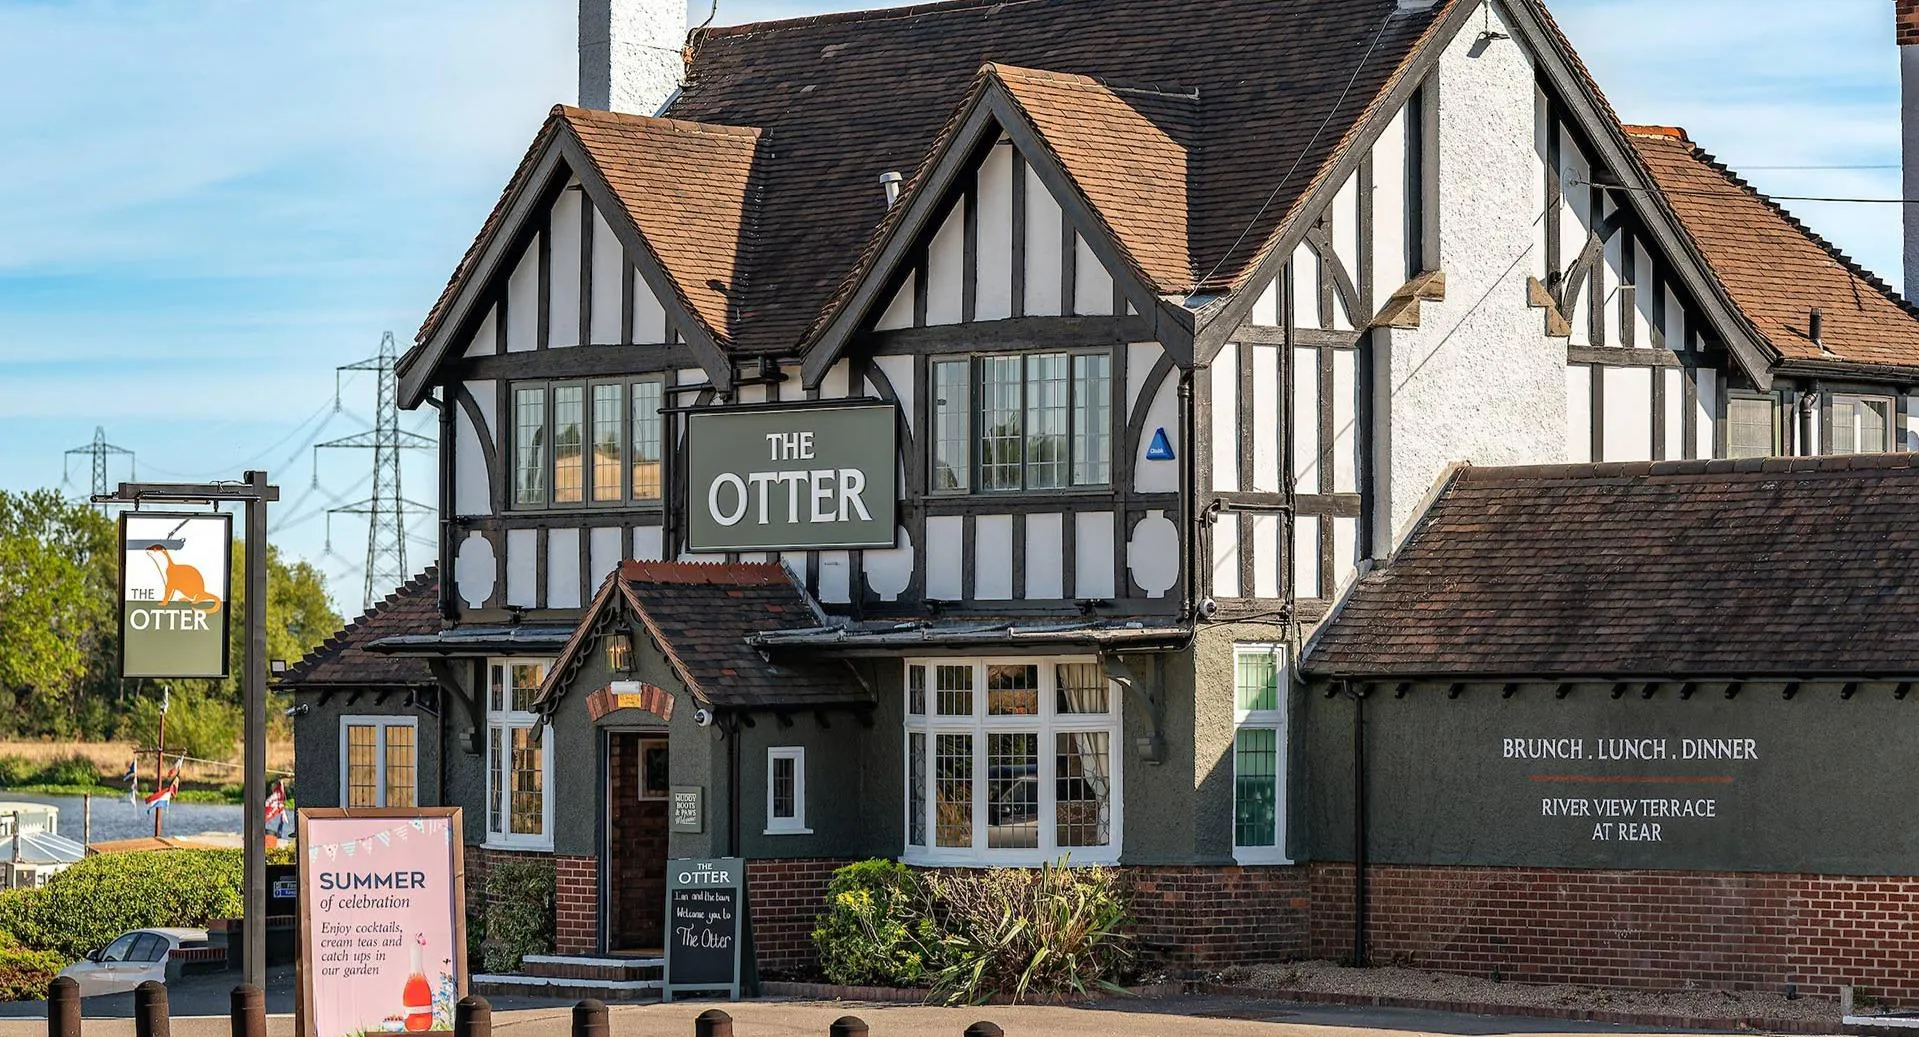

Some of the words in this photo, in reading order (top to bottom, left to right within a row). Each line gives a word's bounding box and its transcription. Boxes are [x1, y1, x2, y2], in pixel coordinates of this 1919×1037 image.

[766, 432, 815, 460] THE
[708, 468, 873, 526] OTTER
[132, 589, 154, 599] THE
[130, 609, 210, 630] OTTER
[1503, 738, 1582, 759] BRUNCH
[1598, 738, 1666, 760] LUNCH
[1682, 738, 1758, 760] DINNER
[1542, 798, 1590, 816] RIVER
[1593, 799, 1638, 816] VIEW
[1640, 800, 1716, 817] TERRACE
[1592, 823, 1612, 840] AT
[1618, 823, 1662, 841] REAR
[320, 872, 426, 890] SUMMER
[678, 871, 730, 884] OTTER
[320, 894, 334, 912] of
[338, 894, 410, 908] celebration
[676, 906, 706, 918] Welcome
[706, 912, 722, 924] you
[722, 908, 731, 920] to
[322, 922, 352, 936] Enjoy
[356, 921, 402, 934] cocktails,
[676, 923, 699, 946] The
[702, 928, 732, 948] Otter
[320, 939, 352, 948] cream
[358, 938, 378, 948] teas
[382, 935, 402, 947] and
[322, 950, 348, 961] catch
[354, 952, 371, 964] ups
[376, 950, 386, 960] in
[322, 966, 340, 976] our
[343, 964, 379, 978] garden
